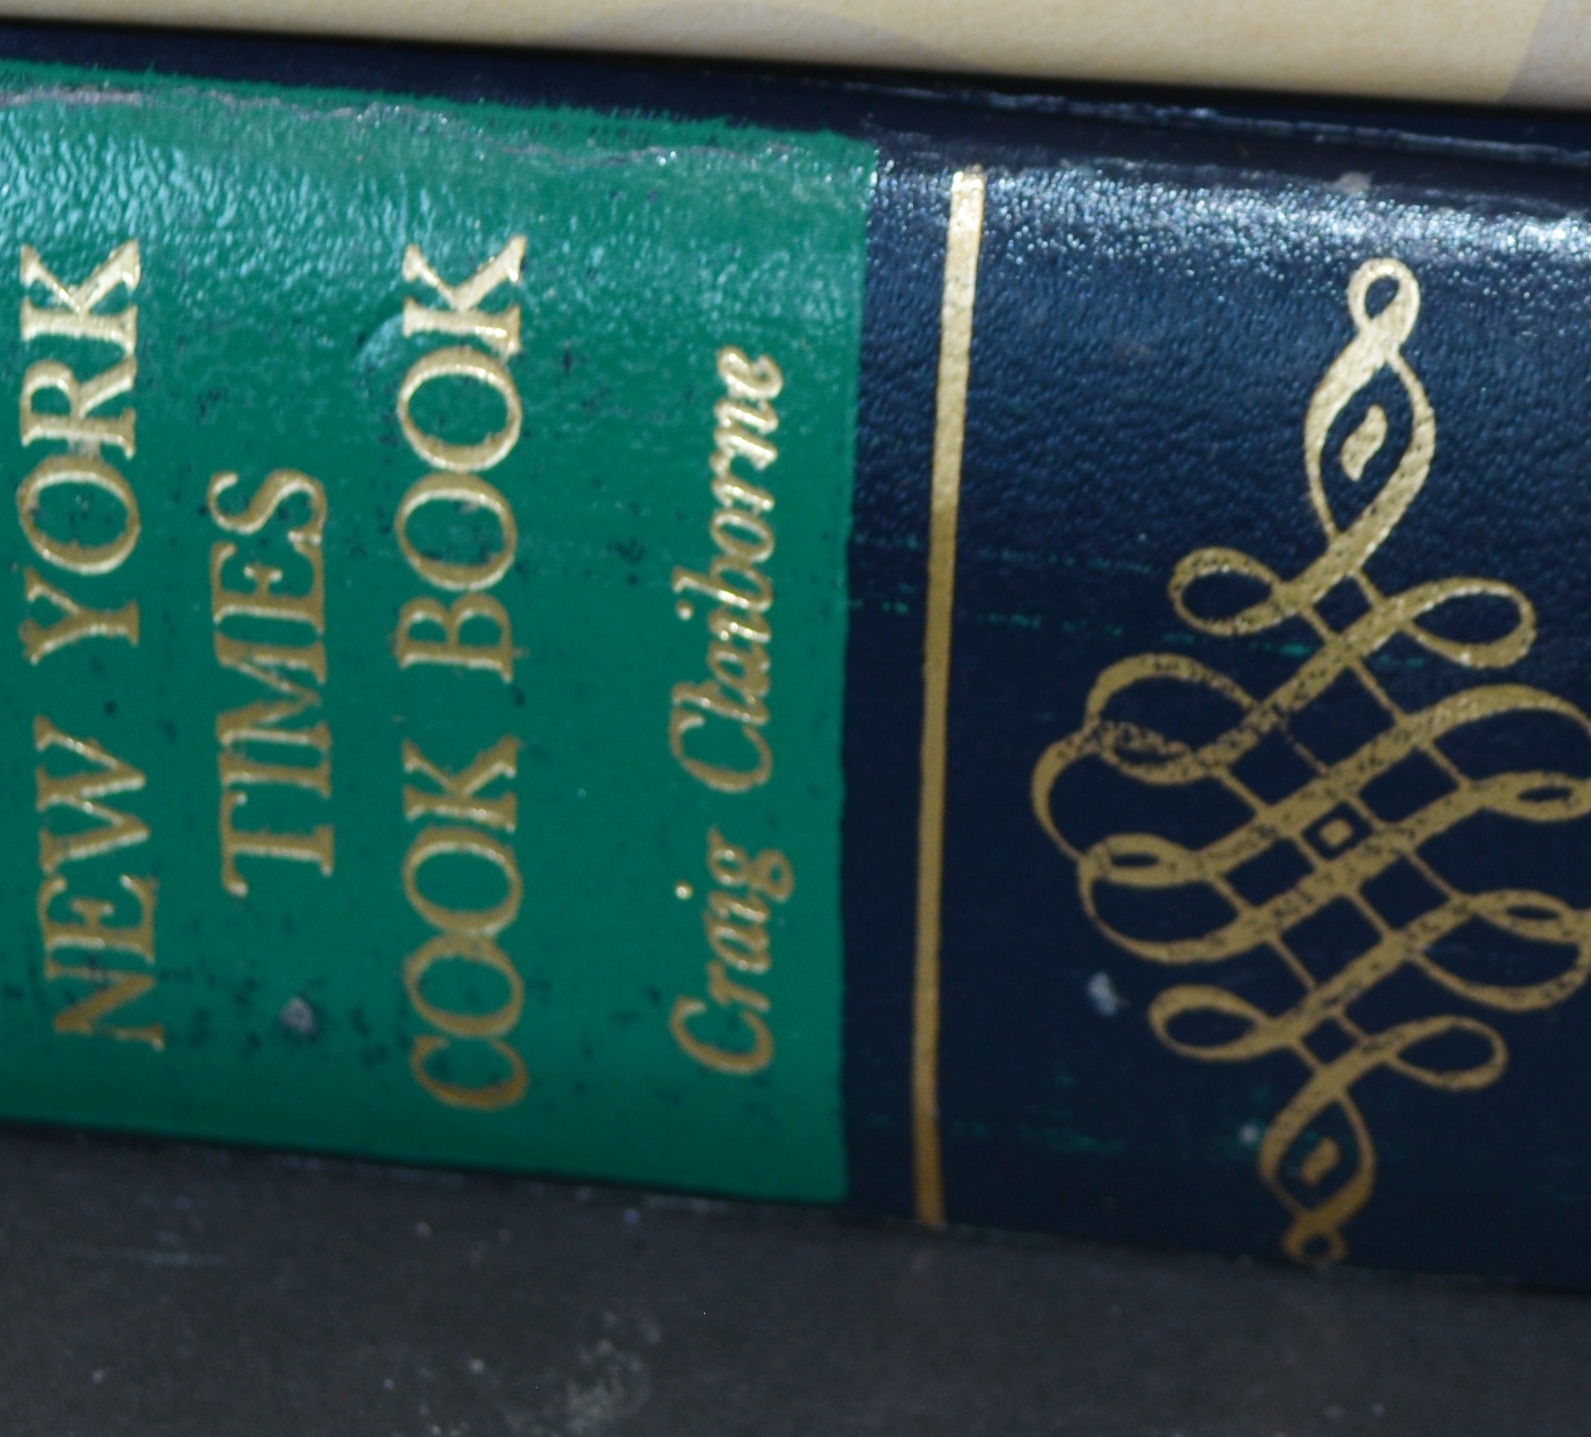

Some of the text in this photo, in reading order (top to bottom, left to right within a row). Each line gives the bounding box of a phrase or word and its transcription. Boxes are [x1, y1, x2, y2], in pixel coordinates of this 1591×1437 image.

[18, 238, 166, 1051] NEW YORK
[206, 467, 333, 898] TIMES
[393, 233, 530, 1110] COOK BOOK
[668, 344, 796, 1079] Craig Claiborne
